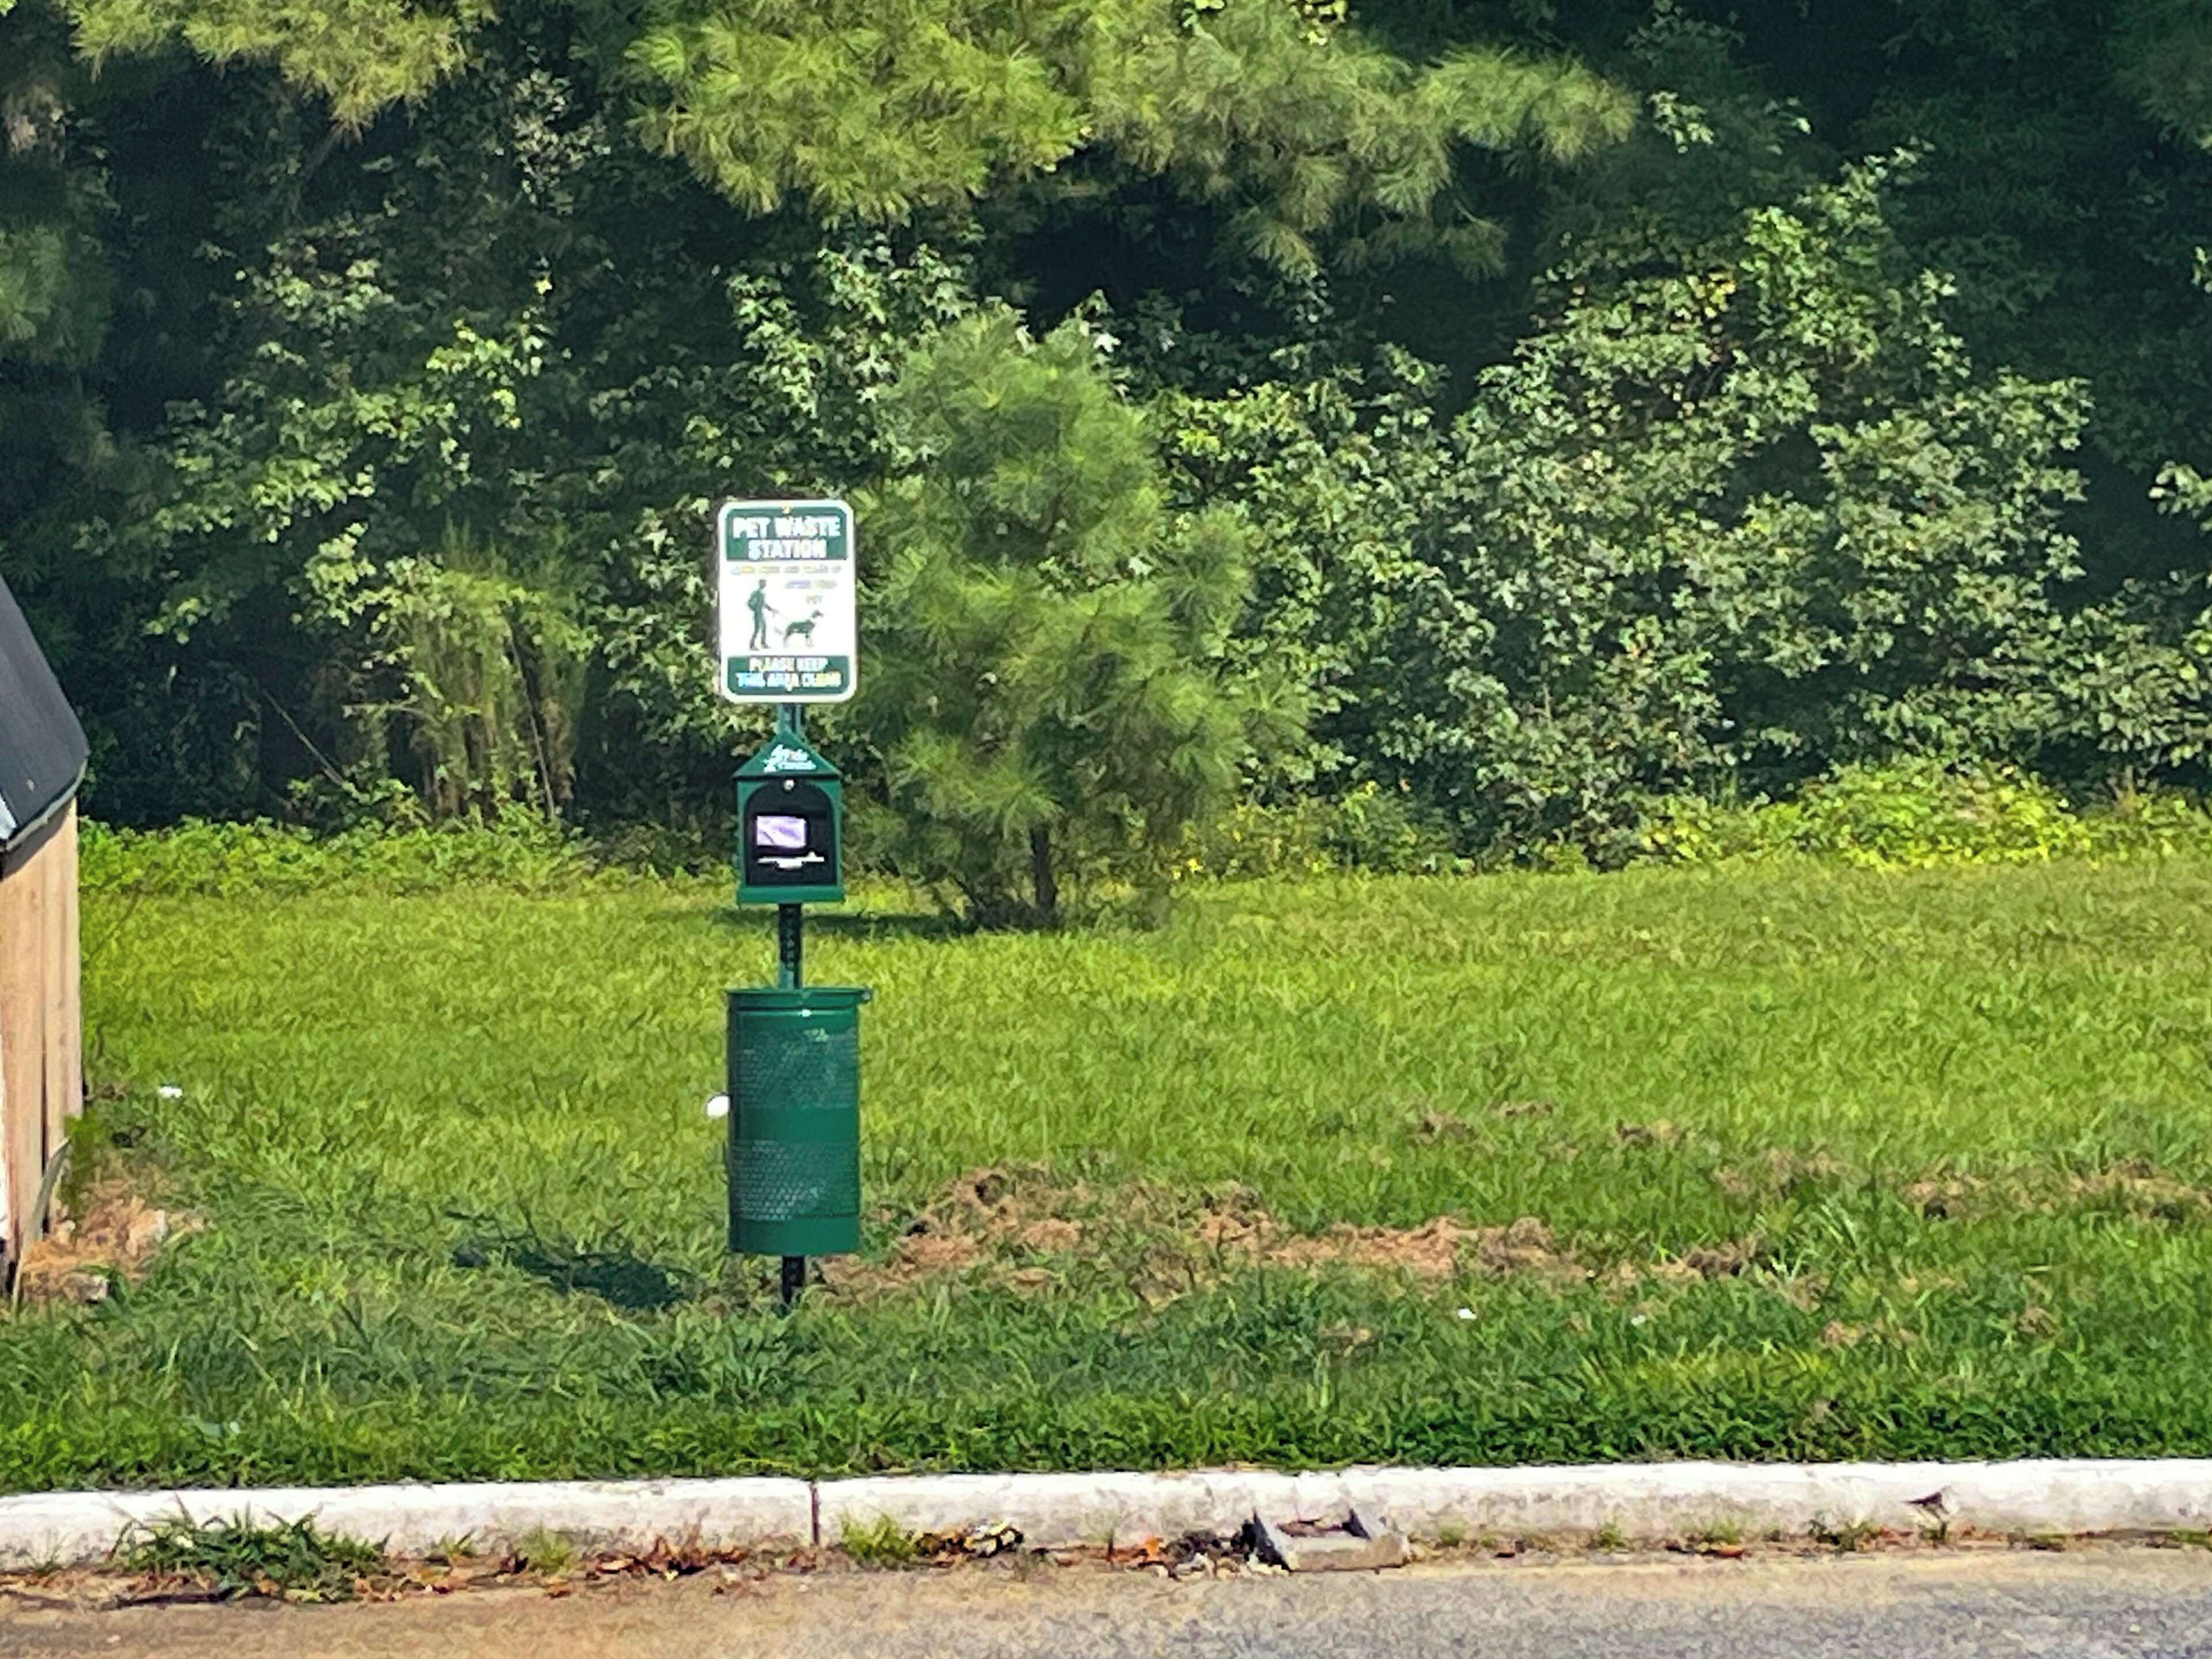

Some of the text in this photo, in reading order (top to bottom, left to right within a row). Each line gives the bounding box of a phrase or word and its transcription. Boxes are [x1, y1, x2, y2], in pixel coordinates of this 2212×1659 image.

[733, 516, 841, 538] PET WASTE
[748, 539, 827, 559] STATION
